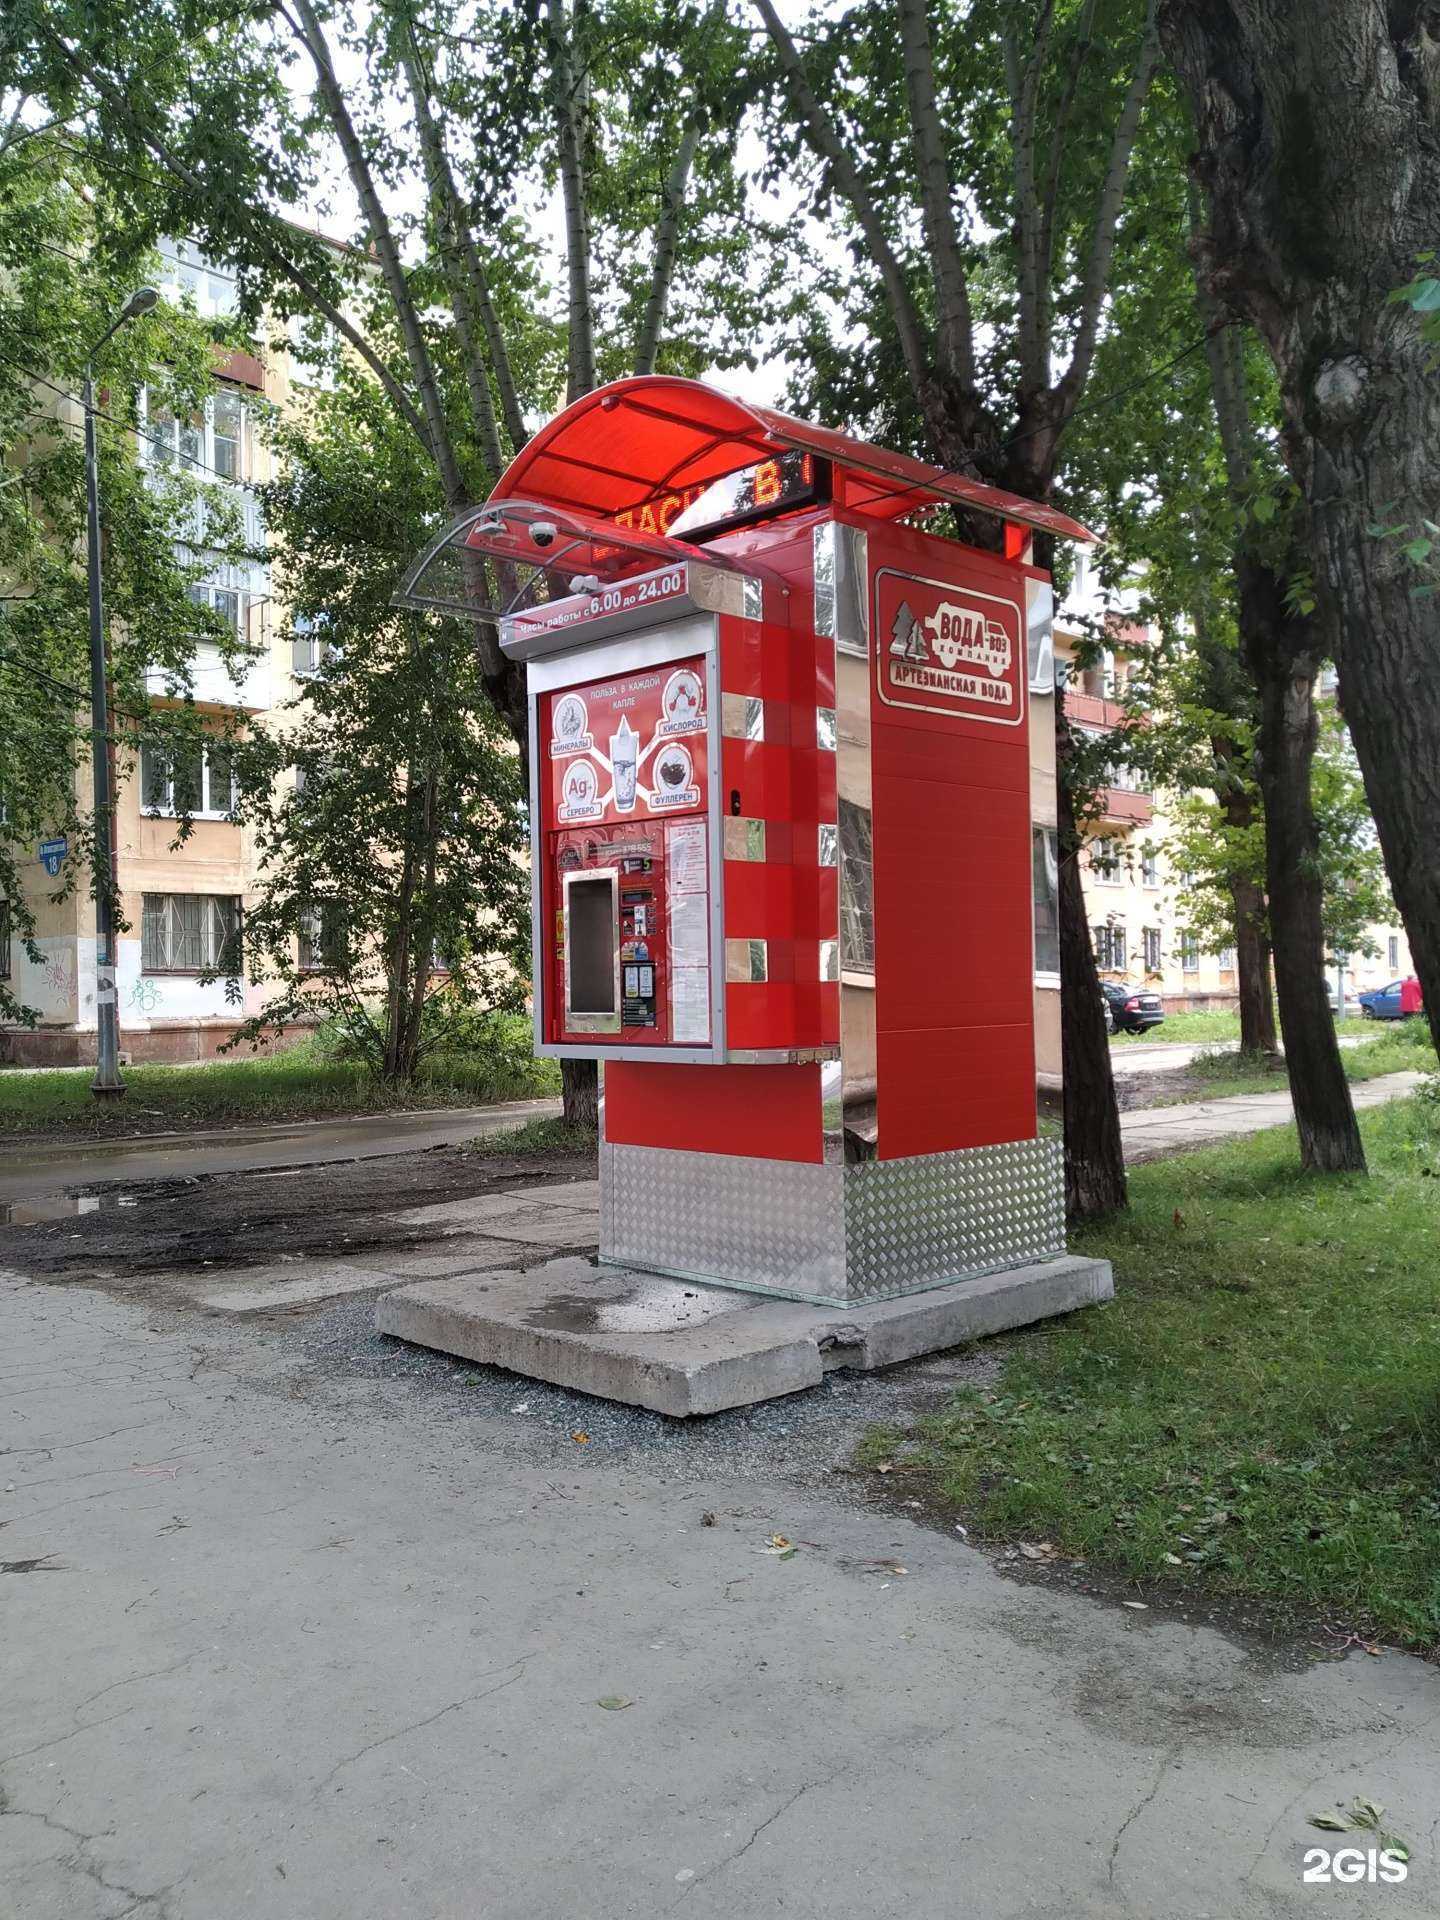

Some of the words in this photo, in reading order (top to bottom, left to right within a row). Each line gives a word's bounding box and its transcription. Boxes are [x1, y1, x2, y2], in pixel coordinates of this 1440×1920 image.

[520, 620, 545, 633] Часы
[546, 611, 581, 629] работы
[590, 590, 622, 613] 6.00
[623, 595, 636, 608] до
[638, 573, 681, 602] 24.00
[939, 644, 1007, 666] КОМПАНИЯ
[590, 687, 617, 700] ПОЛЬЗА
[629, 675, 661, 691] КАЖДОЙ
[894, 665, 977, 695] АРТЕЗИАНСКАЯ
[981, 682, 1008, 702] ВОДА
[612, 697, 636, 710] КАПЛЕ
[662, 720, 703, 733] КИСЛОРОД
[553, 740, 589, 752] МИНЕРАЛЫ
[655, 793, 693, 805] ФУЛЛЕРЕН
[566, 806, 595, 817] СЕРЕБРО
